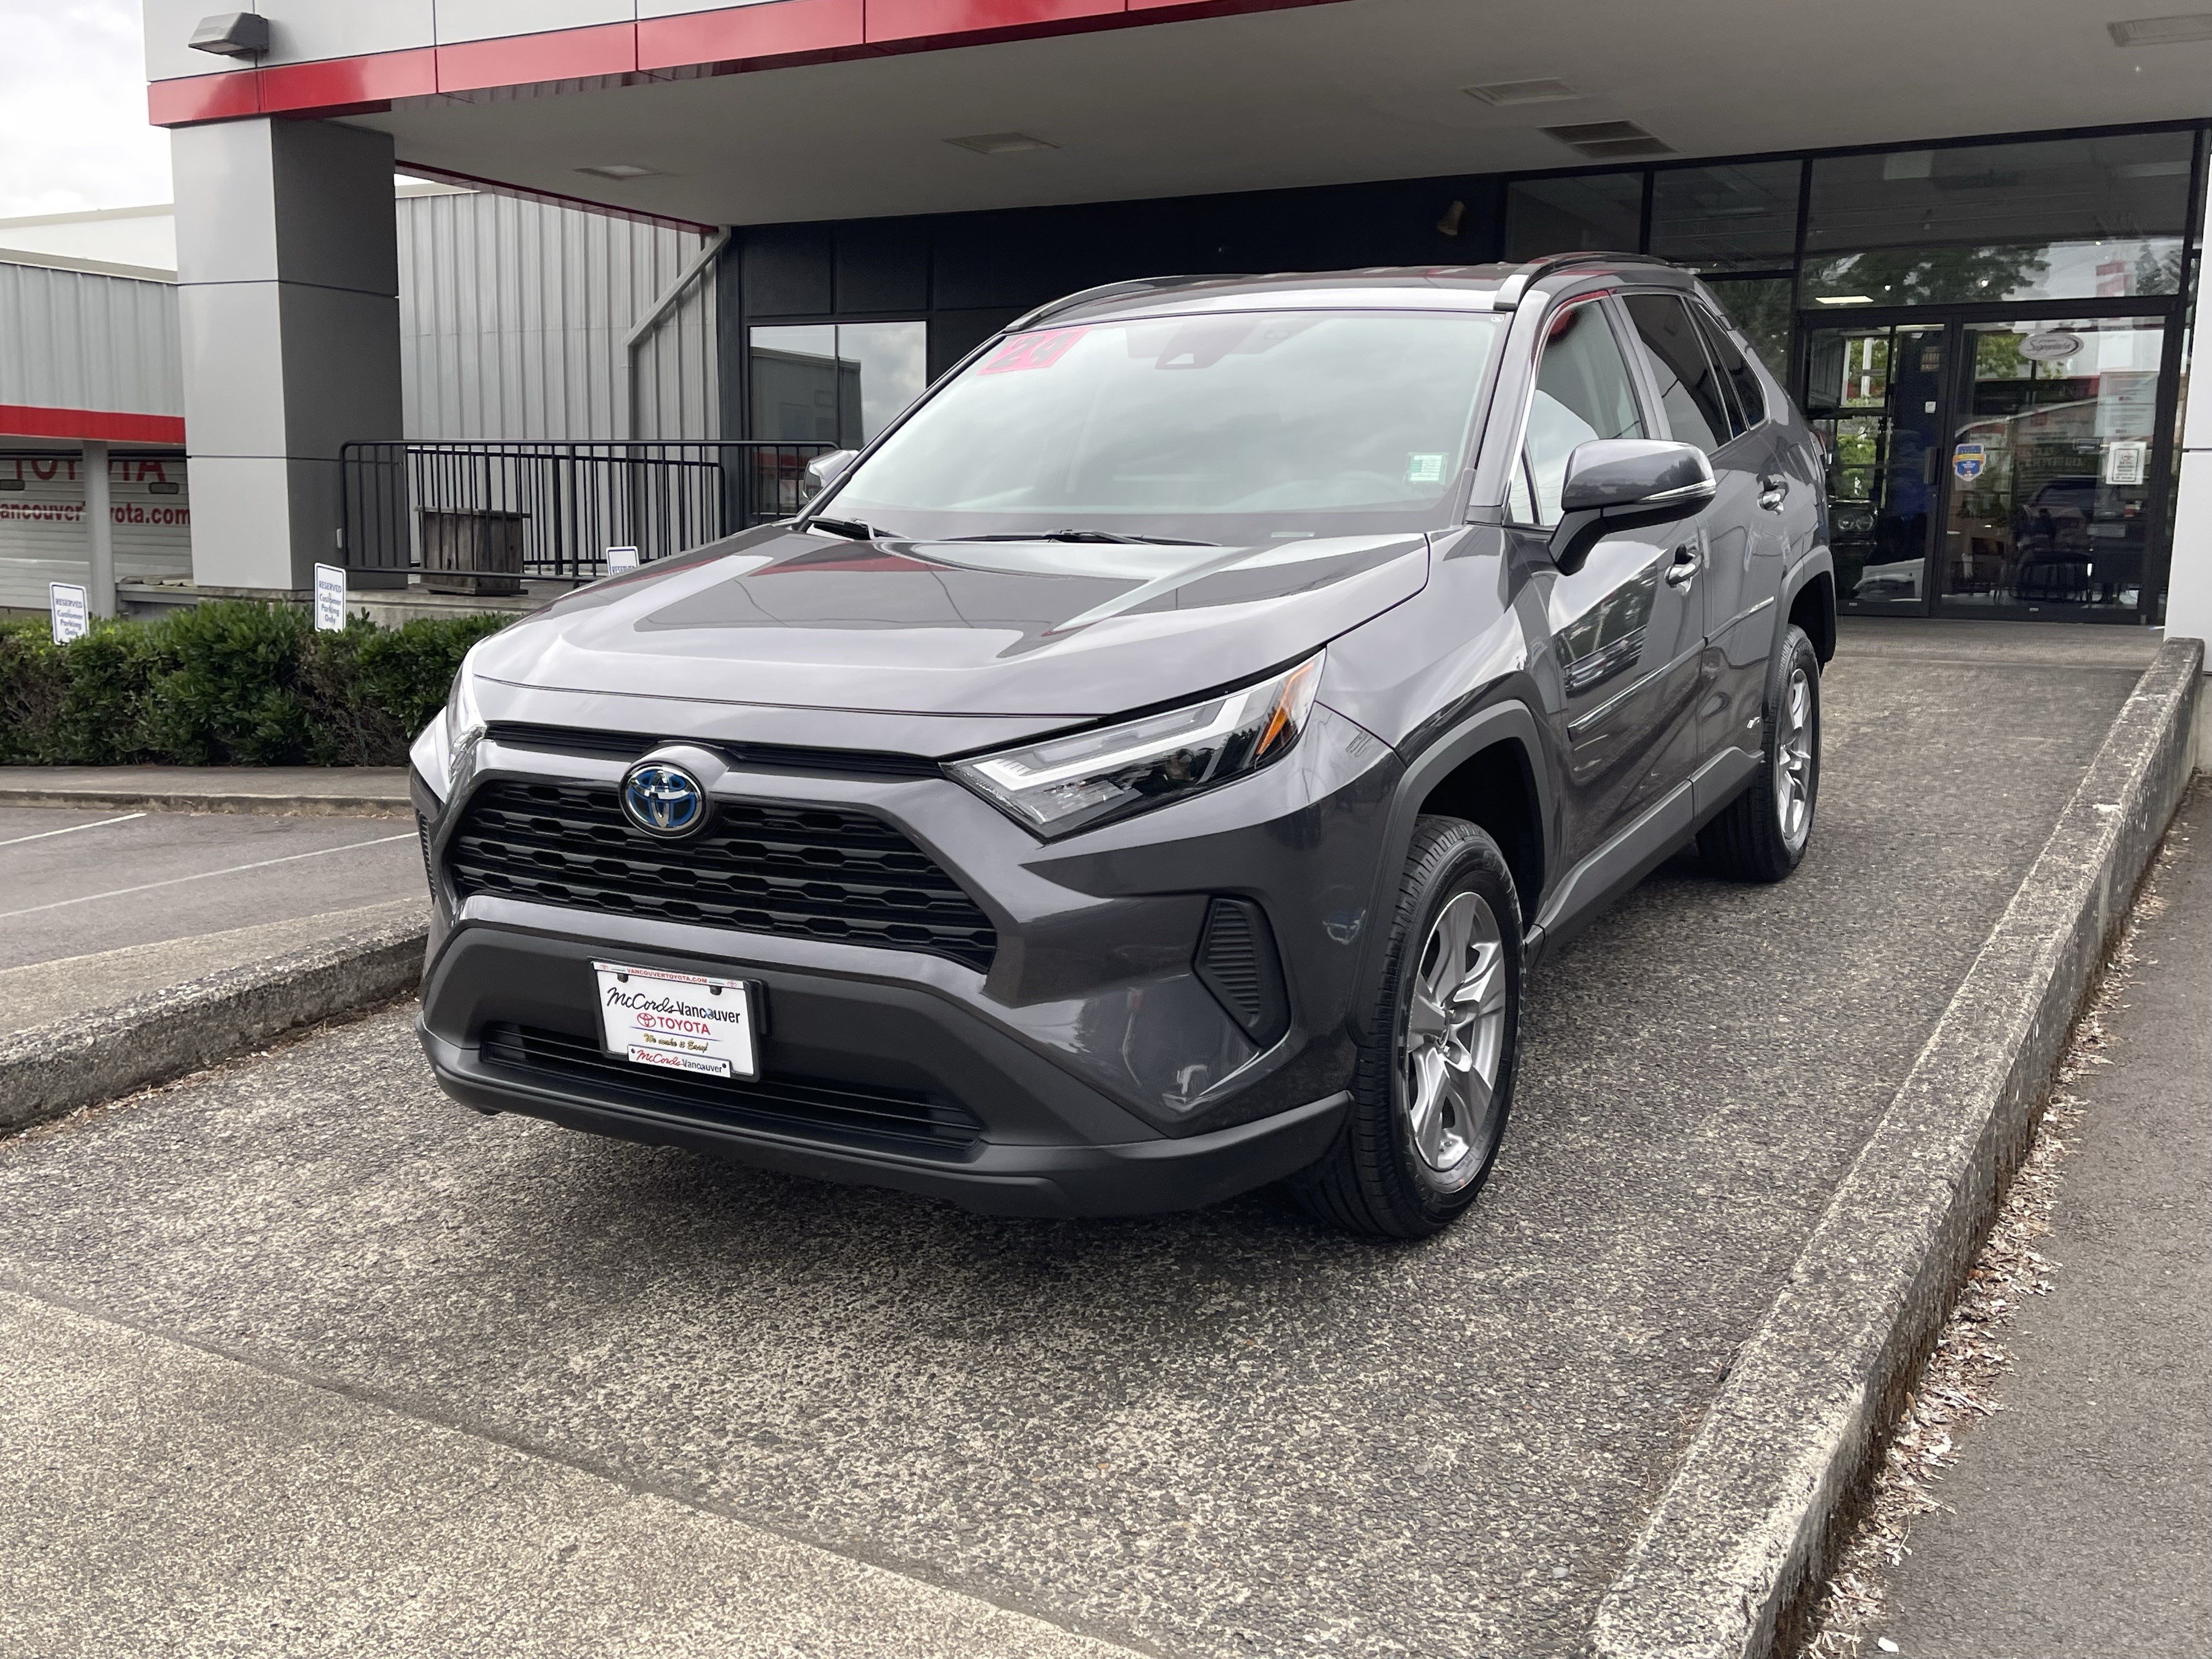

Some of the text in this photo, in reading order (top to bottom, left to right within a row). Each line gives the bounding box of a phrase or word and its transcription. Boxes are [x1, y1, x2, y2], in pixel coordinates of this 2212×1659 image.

[15, 460, 166, 482] TOYTA
[319, 580, 342, 593] RESERVED
[321, 603, 339, 617] Parking
[325, 614, 336, 625] Only
[627, 968, 707, 984] VANCOUVERTOYOTA.COM
[657, 1016, 711, 1035] TOYOTA
